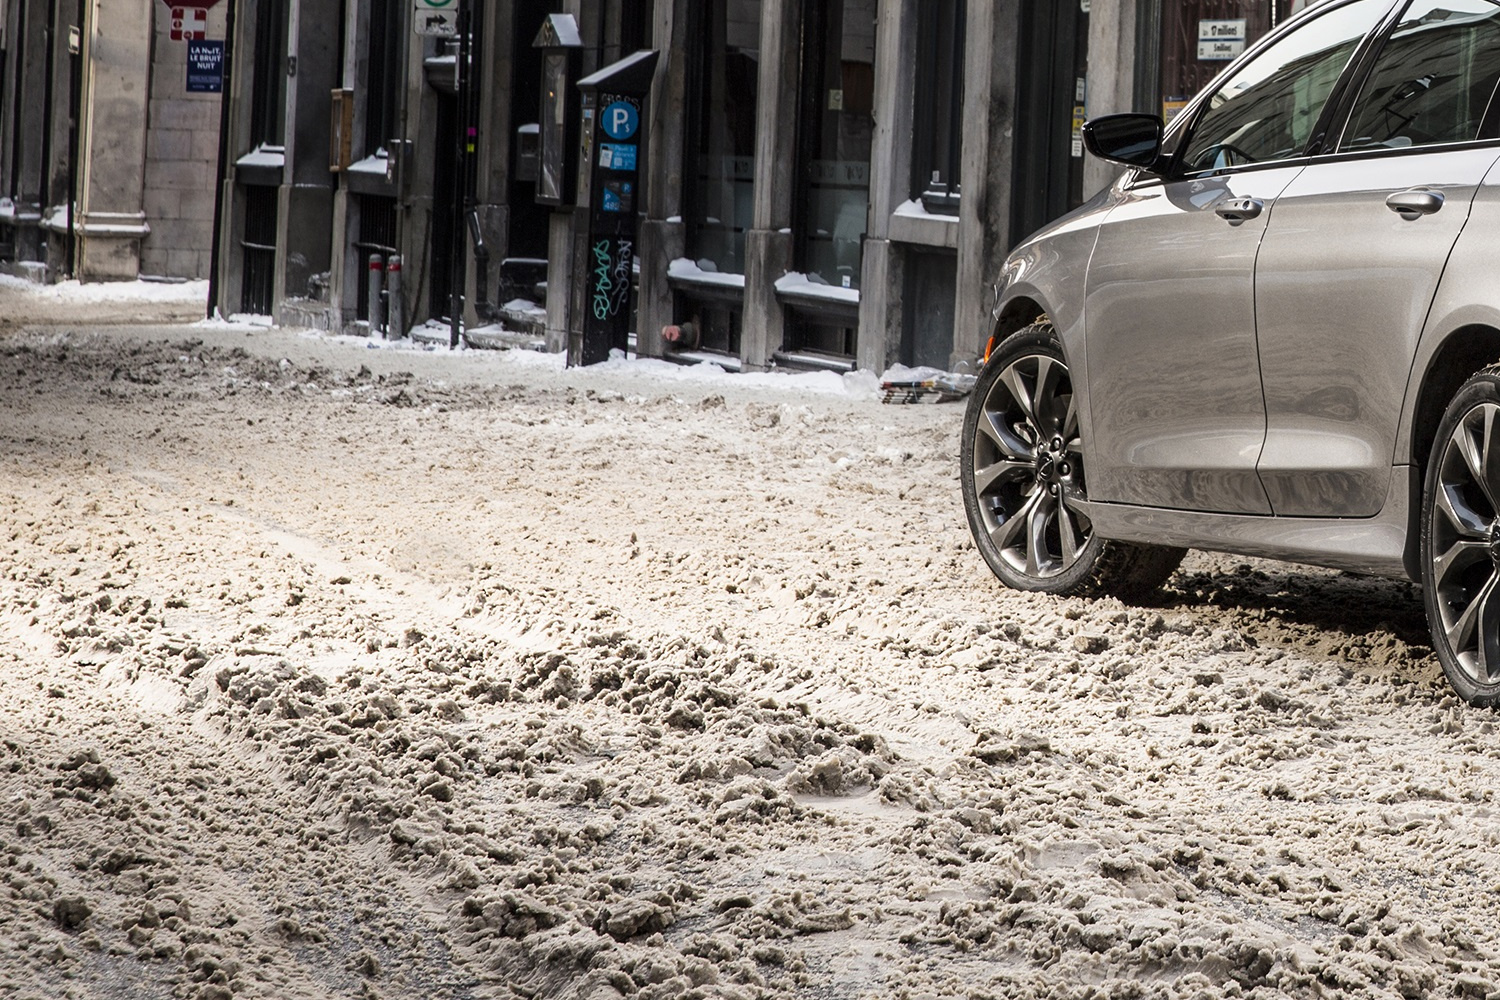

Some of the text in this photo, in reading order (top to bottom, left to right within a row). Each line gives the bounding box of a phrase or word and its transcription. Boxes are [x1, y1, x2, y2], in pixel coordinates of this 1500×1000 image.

[191, 46, 200, 54] LA
[197, 62, 215, 70] NUIT
[613, 108, 628, 134] P
